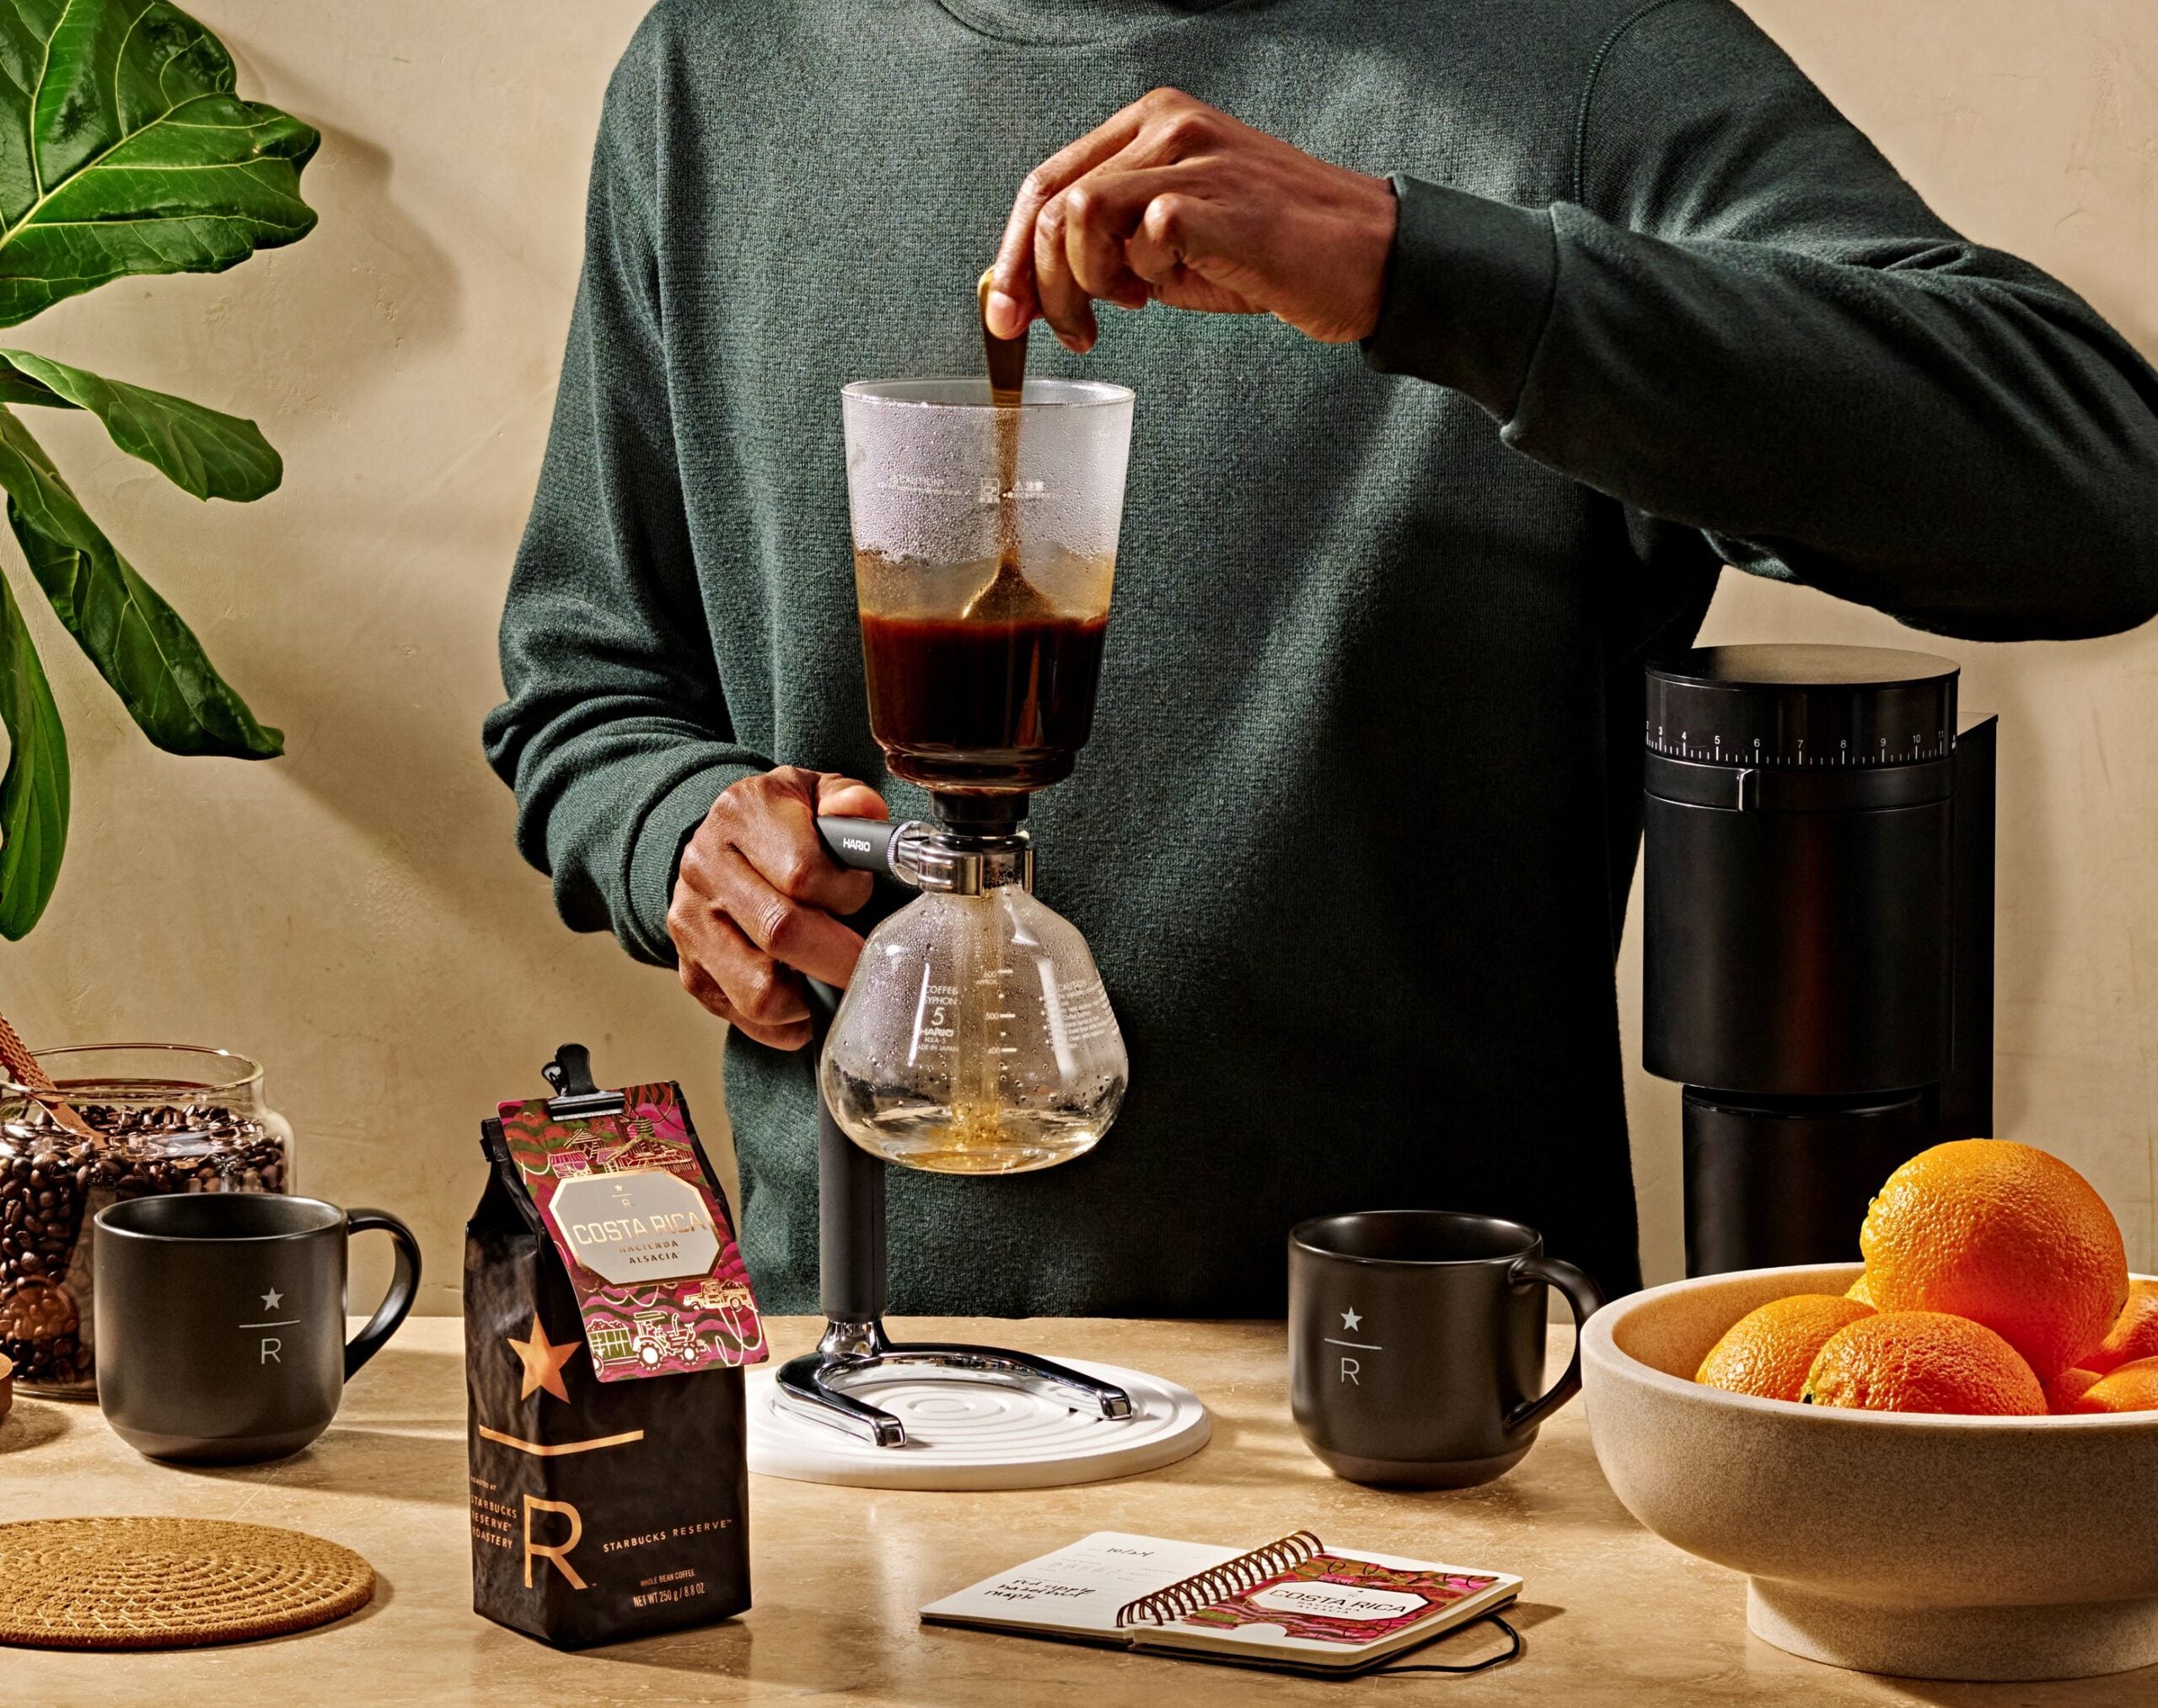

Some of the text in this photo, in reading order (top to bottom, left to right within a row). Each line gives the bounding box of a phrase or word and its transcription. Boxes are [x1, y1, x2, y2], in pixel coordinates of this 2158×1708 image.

[1658, 726, 1663, 735] 3
[1681, 731, 1687, 740] 4
[1715, 735, 1720, 744] 5
[1753, 739, 1760, 748] 6
[1797, 739, 1804, 749] 7
[1840, 739, 1847, 749] 8
[1880, 738, 1887, 747] 9
[1913, 734, 1921, 744] 10
[843, 837, 871, 852] HARIO
[931, 1007, 945, 1026] 5
[621, 1199, 632, 1208] R
[572, 1211, 707, 1245] COSTA RICA
[619, 1240, 679, 1253] HACIENDA
[261, 1338, 282, 1364] R
[1341, 1357, 1360, 1385] R
[471, 1495, 518, 1518] STARBUCKS
[471, 1526, 513, 1550] ROASTERY
[523, 1494, 588, 1590] R
[604, 1531, 666, 1553] STARBUCKS
[1106, 1547, 1155, 1557] 10/24
[641, 1568, 695, 1587] WHOLE BEAN COFFEE
[1044, 1584, 1096, 1593] apple
[633, 1594, 647, 1608] NET
[647, 1592, 658, 1604] WT
[659, 1590, 672, 1603] 250
[674, 1592, 679, 1602] g
[684, 1585, 695, 1598] 8.8
[696, 1582, 706, 1594] OZ
[997, 1583, 1086, 1598] hazelnut
[1269, 1589, 1406, 1613] COSTA RICA
